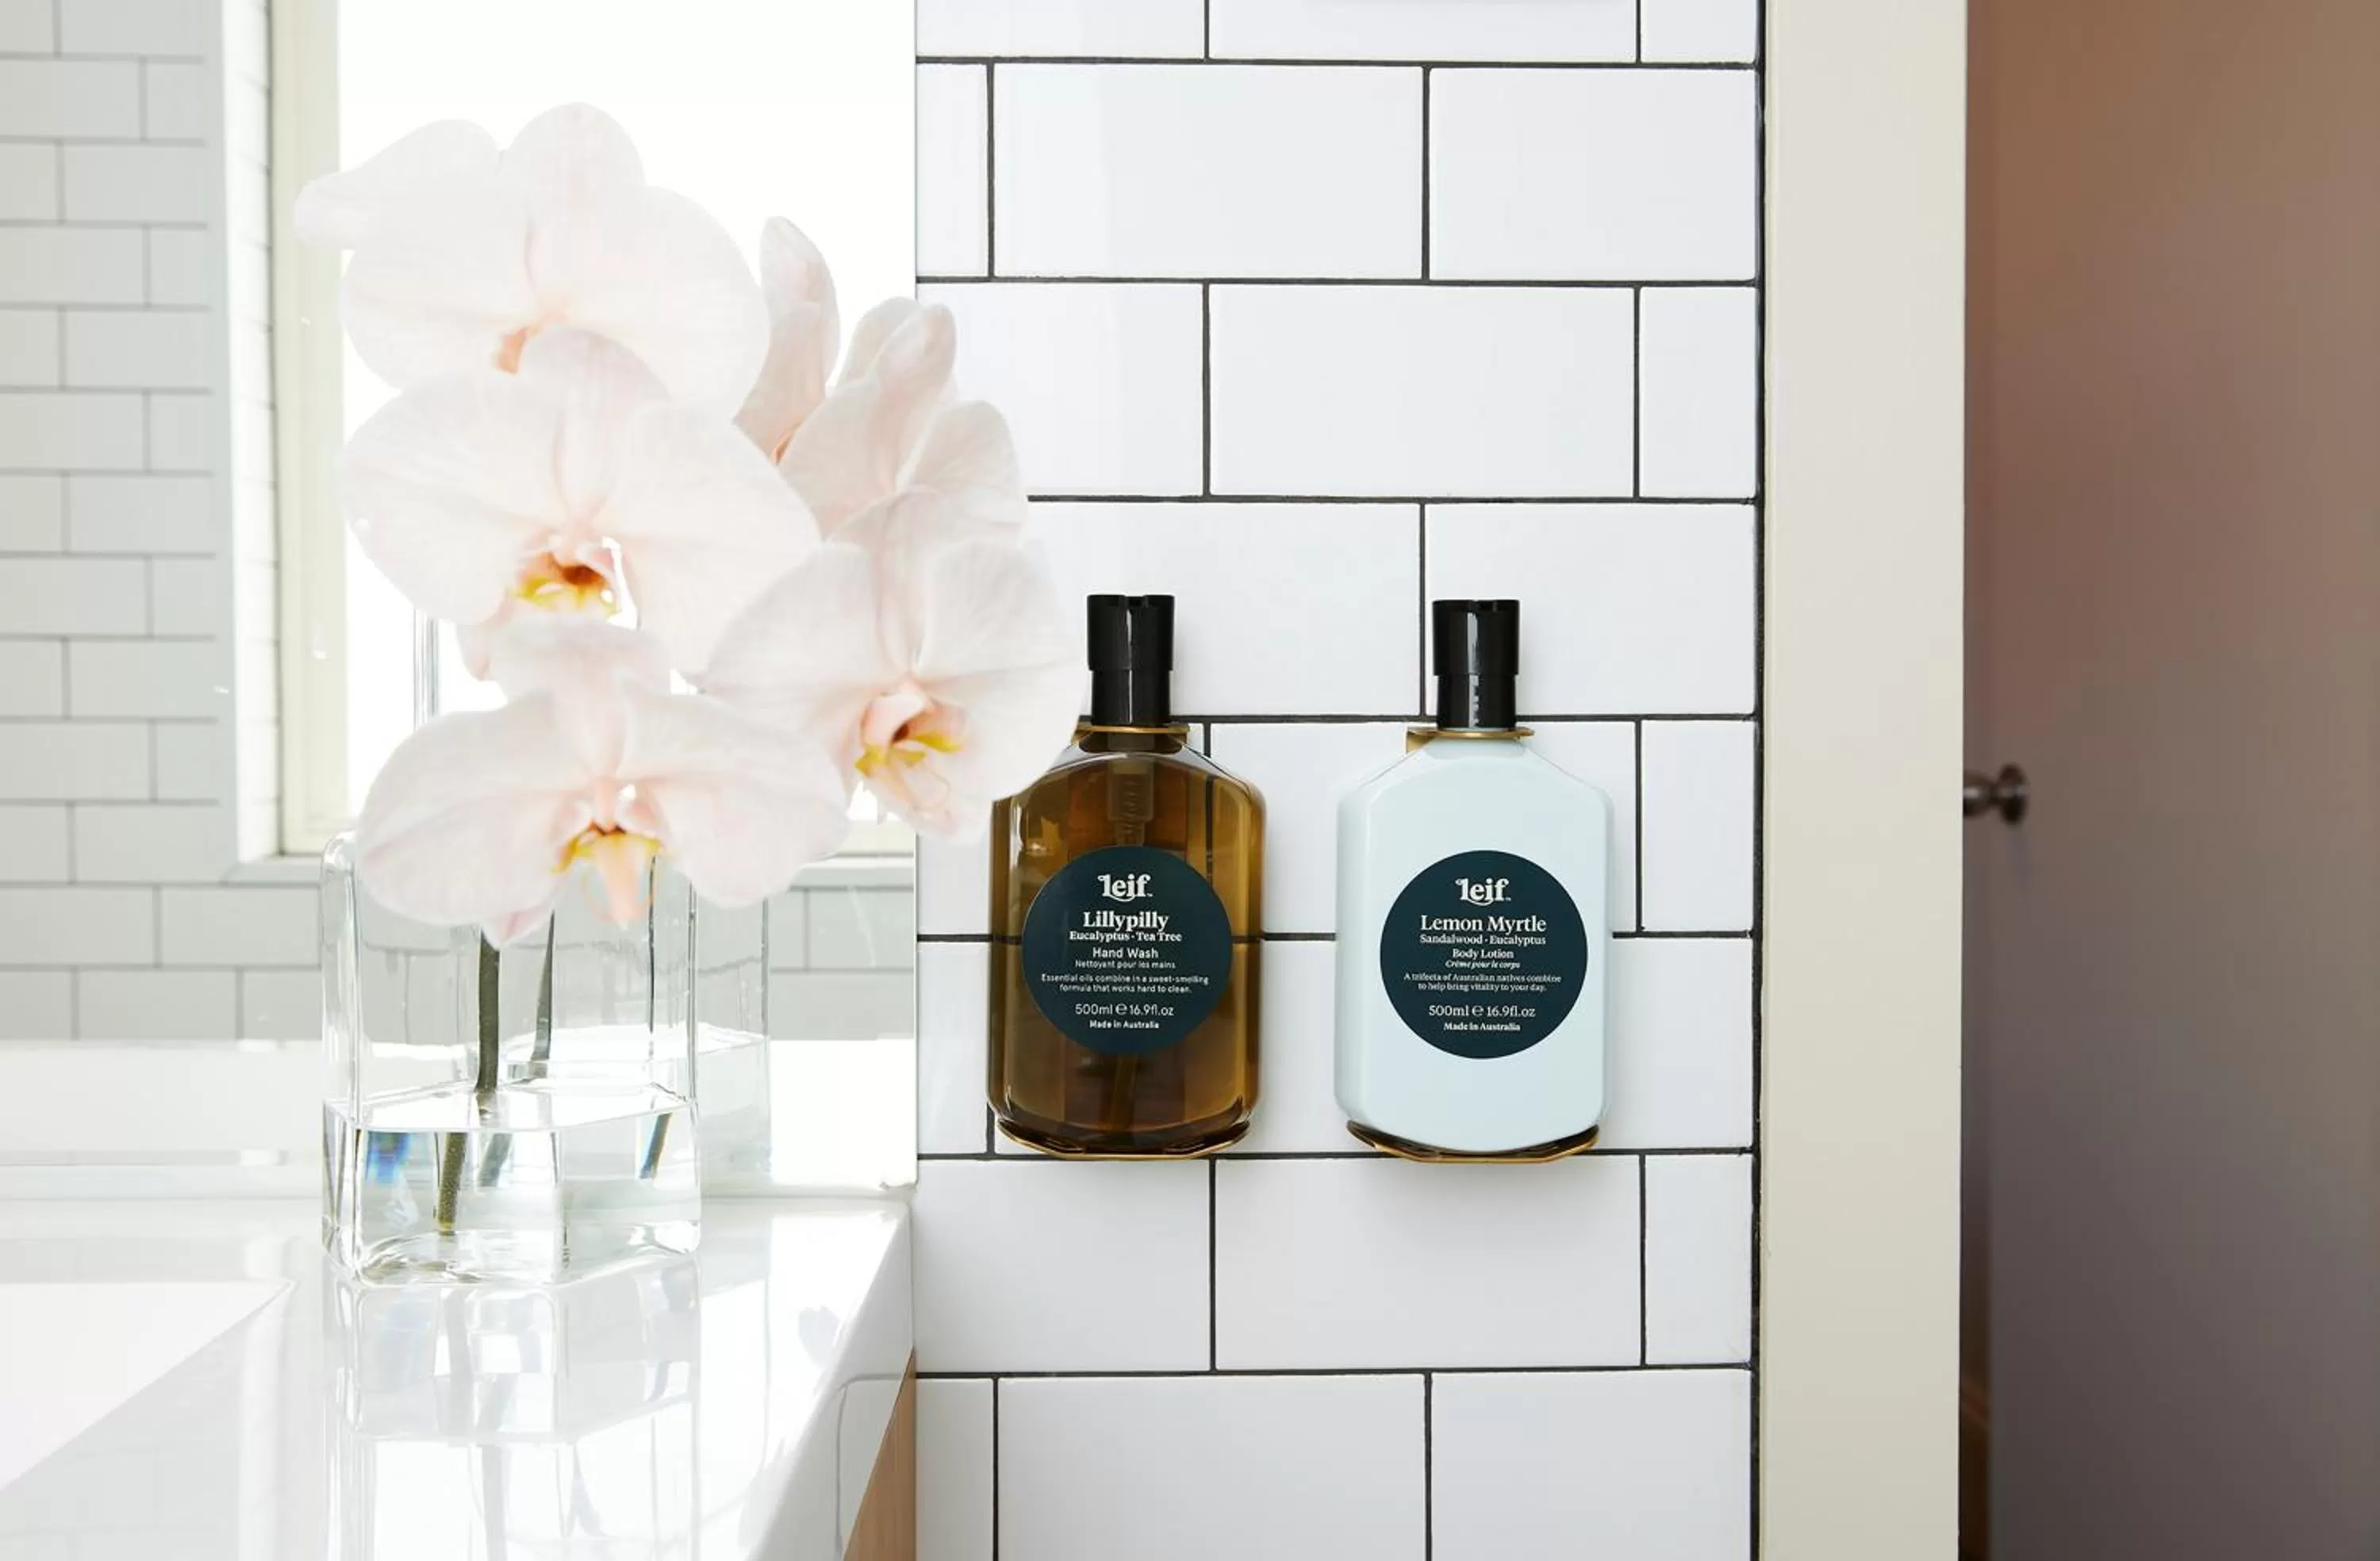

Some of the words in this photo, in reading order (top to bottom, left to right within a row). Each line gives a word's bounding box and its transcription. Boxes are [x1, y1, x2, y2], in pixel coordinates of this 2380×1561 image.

[1084, 911, 1169, 932] Lillypilly
[1421, 915, 1483, 931] Lemon
[1487, 915, 1546, 935] Myrtle
[1069, 930, 1130, 942] Eucalyptus
[1136, 931, 1155, 941] Tea
[1157, 930, 1181, 941] Tree
[1420, 934, 1483, 944] Sandalwood
[1490, 934, 1545, 946] Eucalyptus
[1093, 947, 1123, 958] Hand
[1127, 948, 1158, 958] Wash
[1453, 949, 1479, 960] Body
[1481, 949, 1514, 958] Lotion
[1076, 960, 1115, 968] Nettoyant
[1428, 982, 1445, 991] help
[1076, 1004, 1112, 1014] 500ml
[1130, 1004, 1173, 1015] 16.9fl.oz
[1429, 1005, 1469, 1016] 500ml
[1488, 1006, 1535, 1017] 16.9fl.oz
